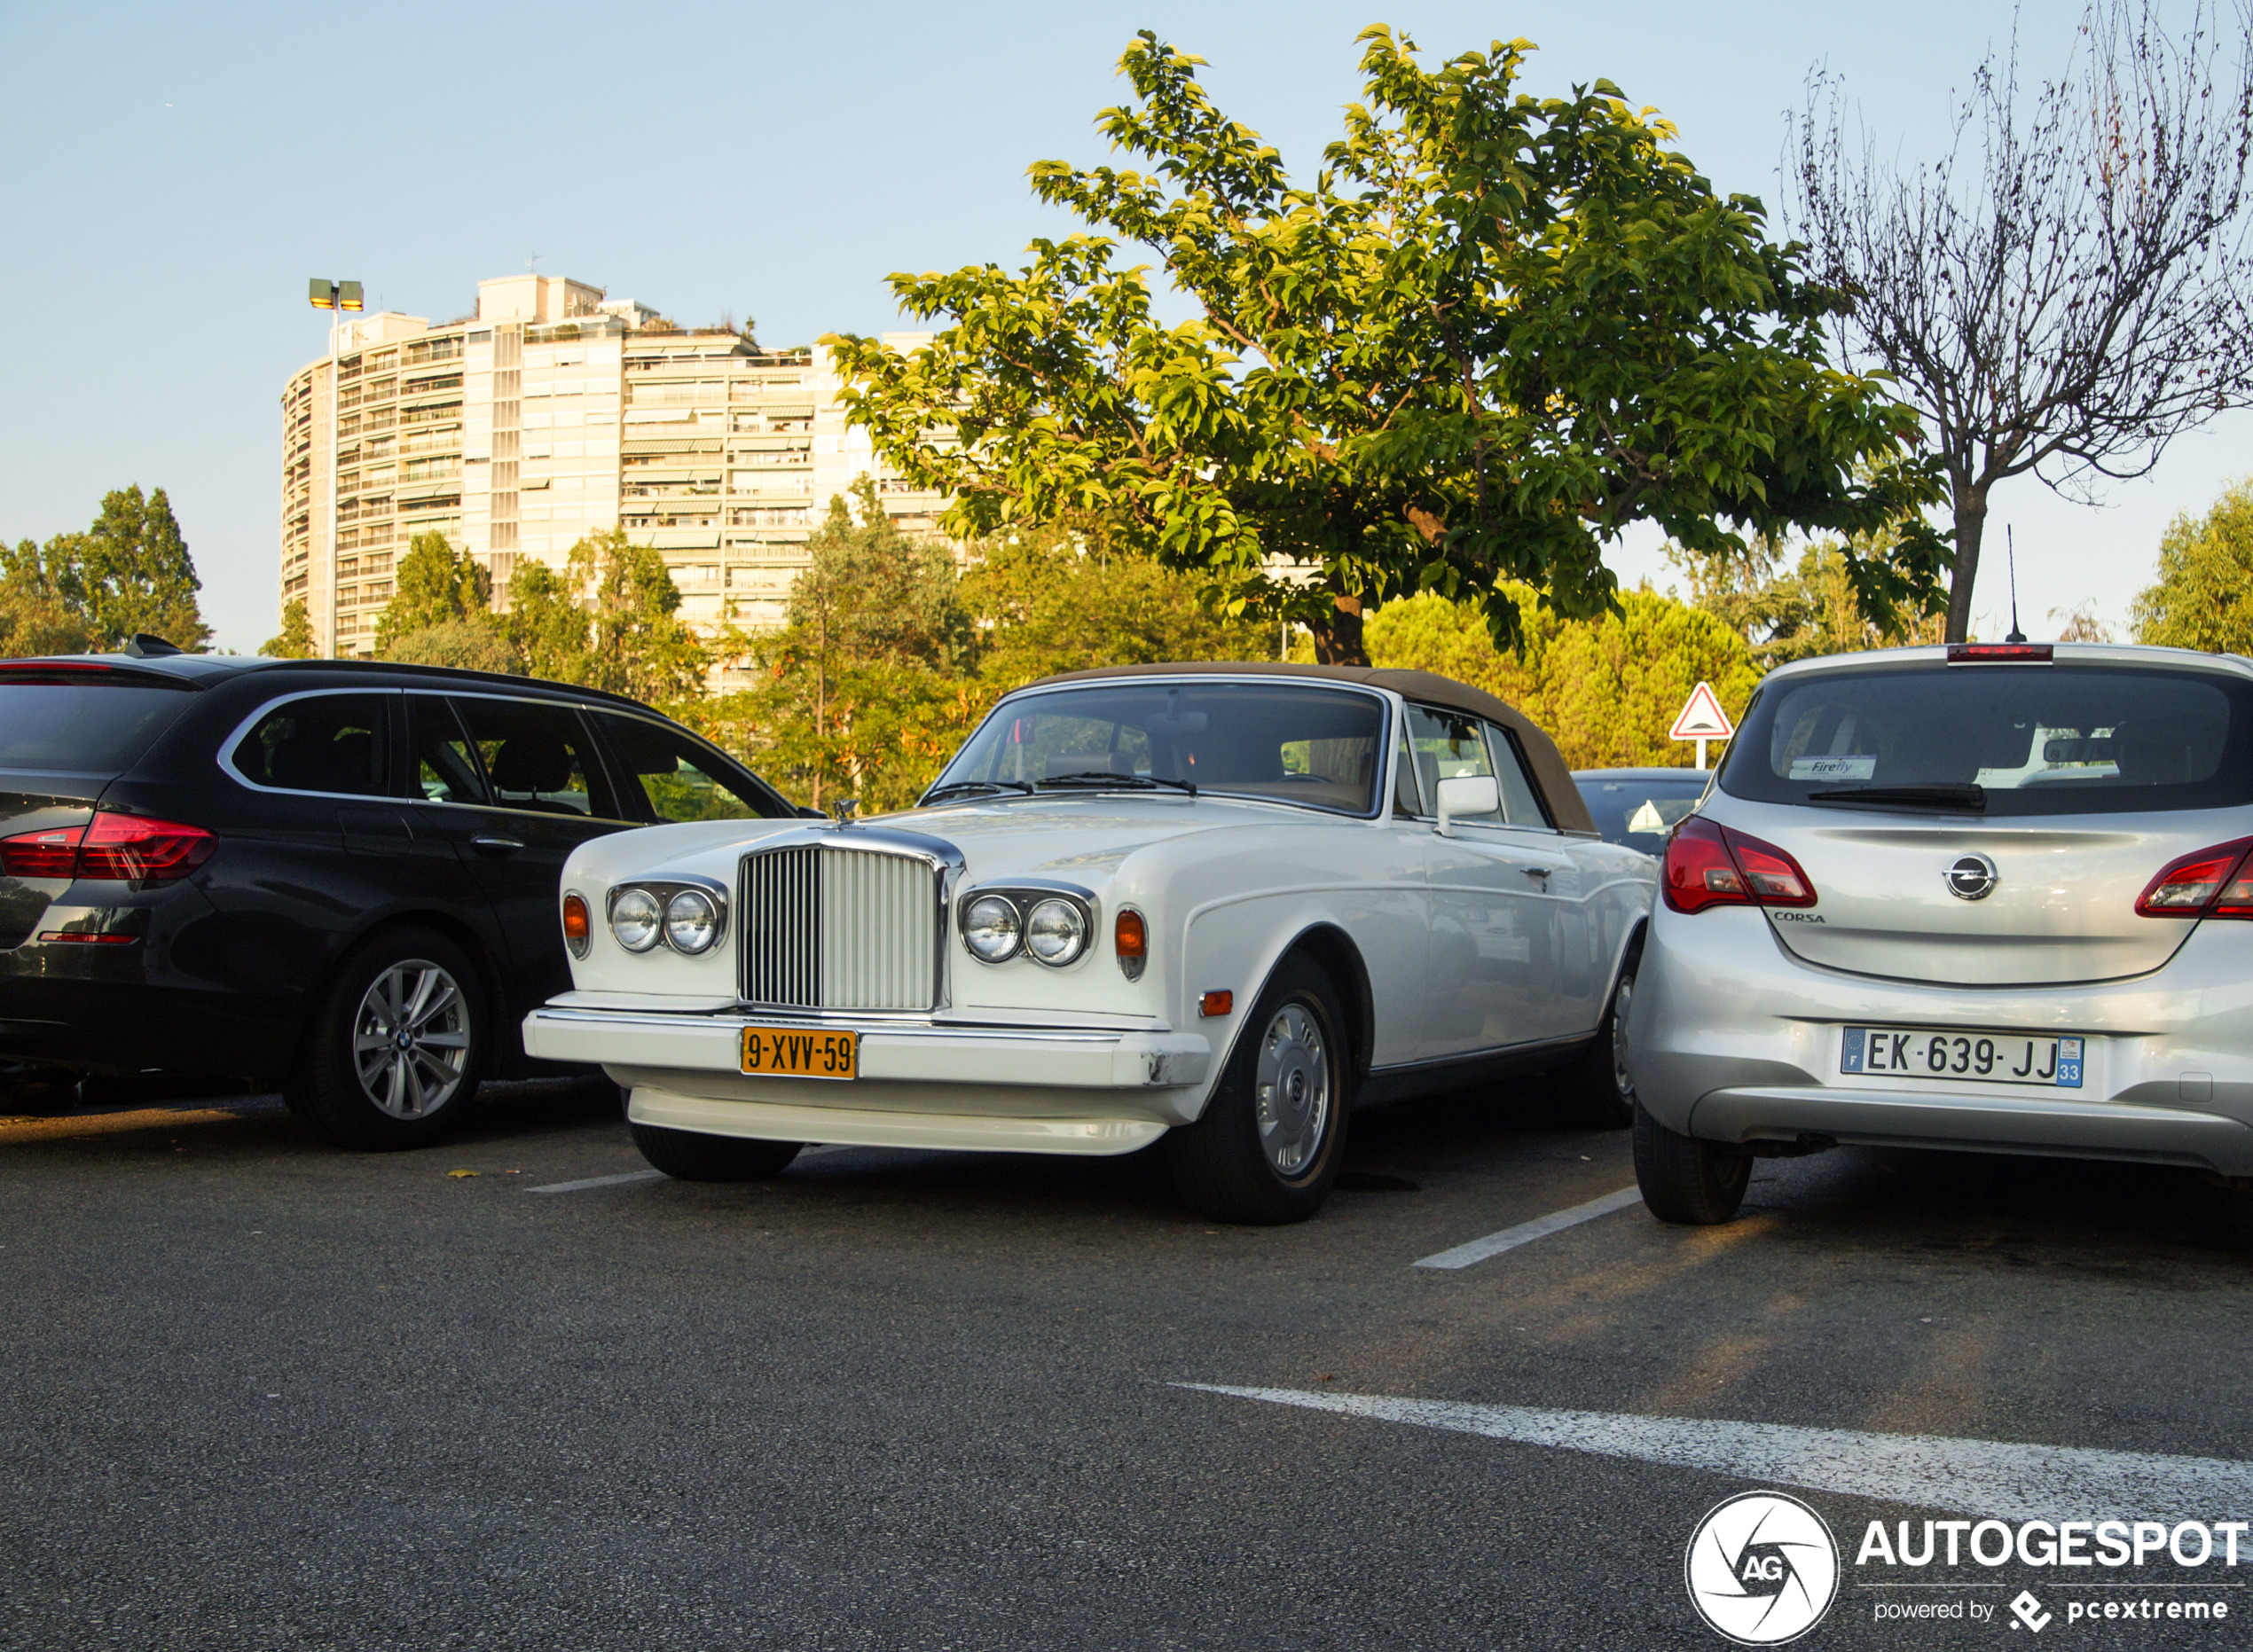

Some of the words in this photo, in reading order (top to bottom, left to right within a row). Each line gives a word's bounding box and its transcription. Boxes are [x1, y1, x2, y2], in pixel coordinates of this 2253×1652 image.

[1812, 761, 1852, 773] Firefly
[1774, 912, 1825, 923] CORSA
[749, 1033, 851, 1072] 9-XVV-59
[1849, 1055, 1857, 1066] F
[2059, 1064, 2079, 1081] 33
